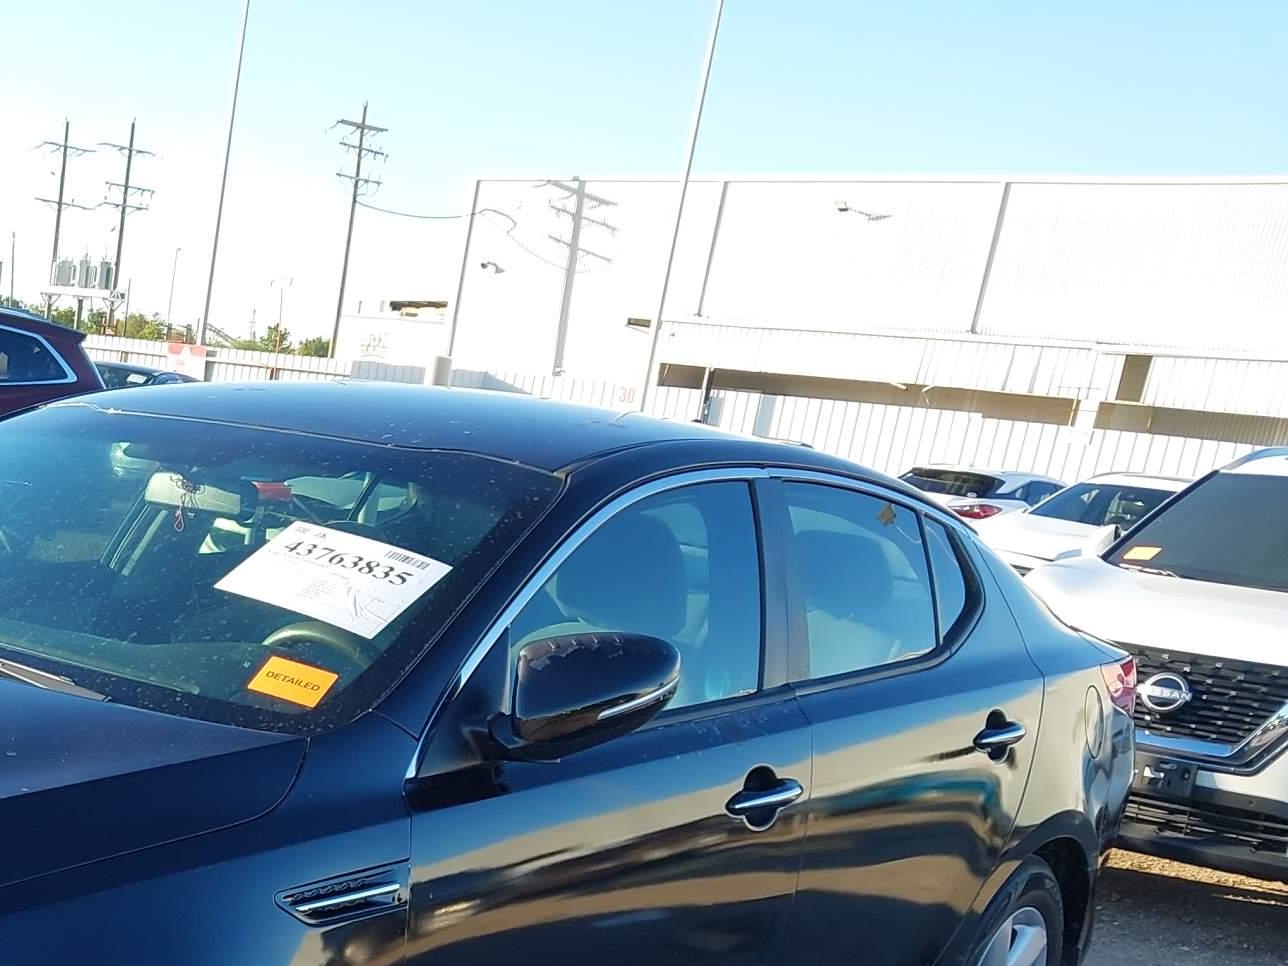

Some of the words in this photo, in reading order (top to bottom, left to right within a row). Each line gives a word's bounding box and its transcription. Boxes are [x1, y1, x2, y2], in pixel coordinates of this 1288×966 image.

[284, 541, 414, 585] 43763835
[265, 670, 321, 692] DETAILED
[1139, 684, 1192, 701] SAN
